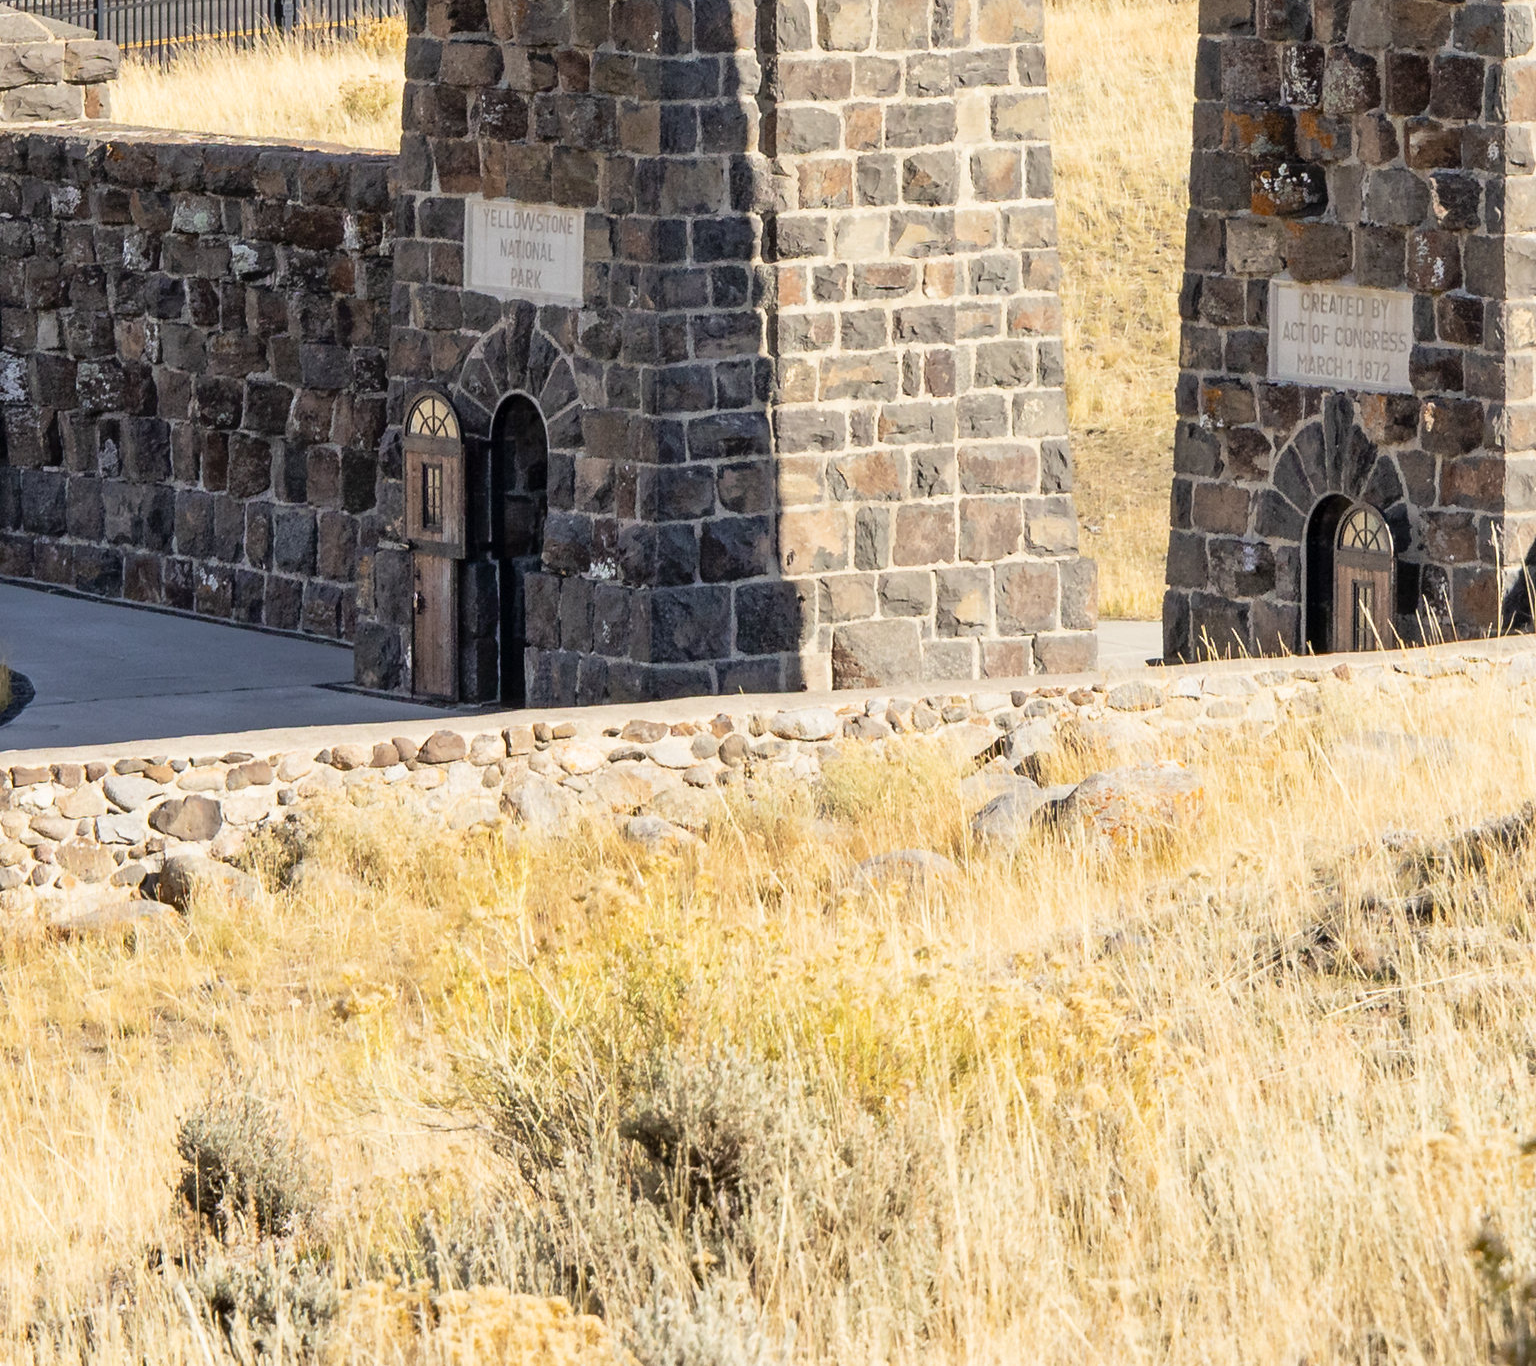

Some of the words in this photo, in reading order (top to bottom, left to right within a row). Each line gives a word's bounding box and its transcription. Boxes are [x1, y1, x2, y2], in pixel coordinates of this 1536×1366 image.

[483, 209, 573, 235] YELLOWSTONE
[500, 238, 555, 262] NATIONAL
[511, 268, 542, 289] PARK
[1301, 292, 1365, 317] CREATED
[1371, 298, 1390, 319] BY
[1282, 321, 1306, 343] ACT
[1312, 324, 1329, 345] OF
[1335, 327, 1408, 353] CONGRESS
[1296, 354, 1343, 378] MARCH
